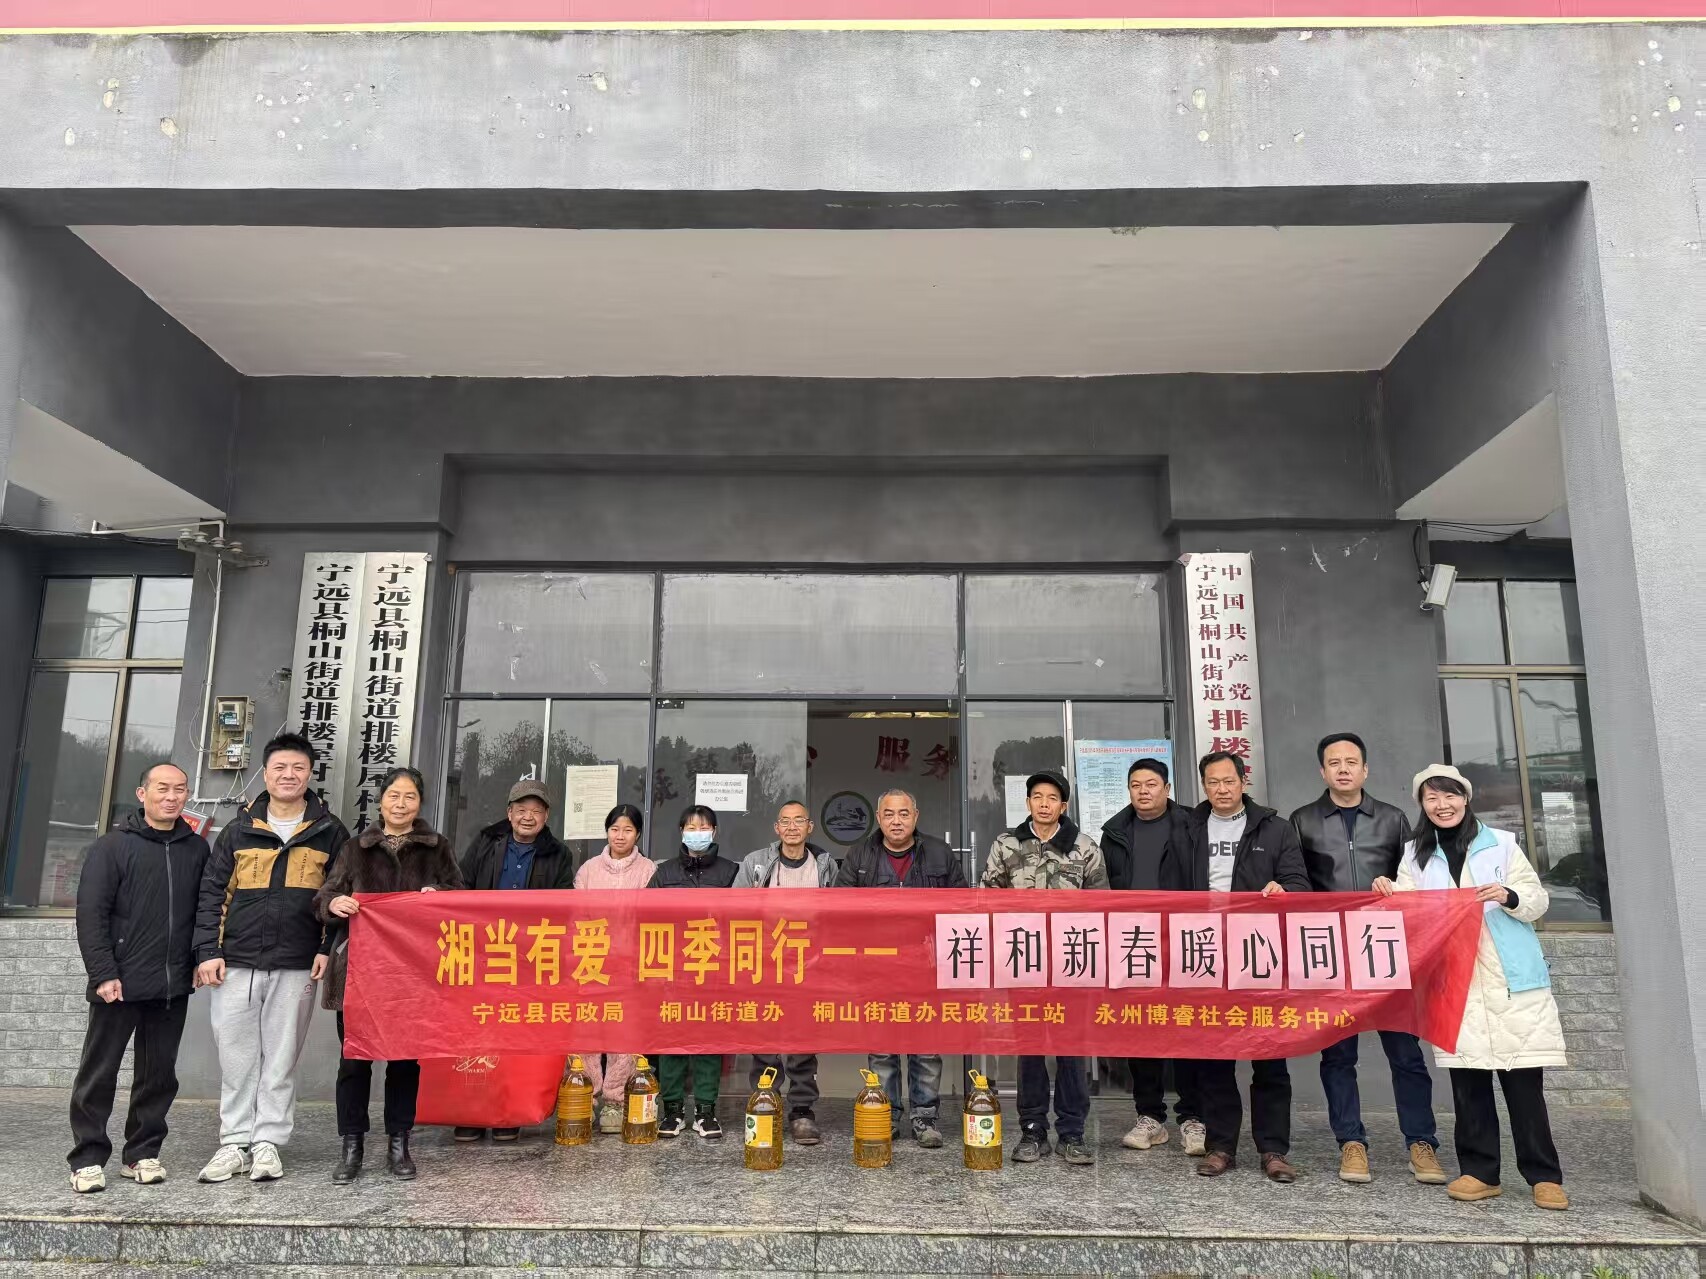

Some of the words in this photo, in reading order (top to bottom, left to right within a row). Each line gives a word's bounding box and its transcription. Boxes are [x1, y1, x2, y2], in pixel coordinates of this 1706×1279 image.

[1195, 564, 1226, 702] 宁远县桐山街道
[1221, 564, 1252, 701] 中国共产党
[436, 917, 611, 986] 湘当有爱
[946, 924, 1400, 980] 祥和新春暖心同行
[472, 1001, 624, 1024] 宁远县民政局
[659, 1001, 785, 1024] 桐山街道办
[812, 1001, 1066, 1024] 桐山街道办民政社工站
[1094, 1003, 1356, 1030] 永州博睿社会服务中心
